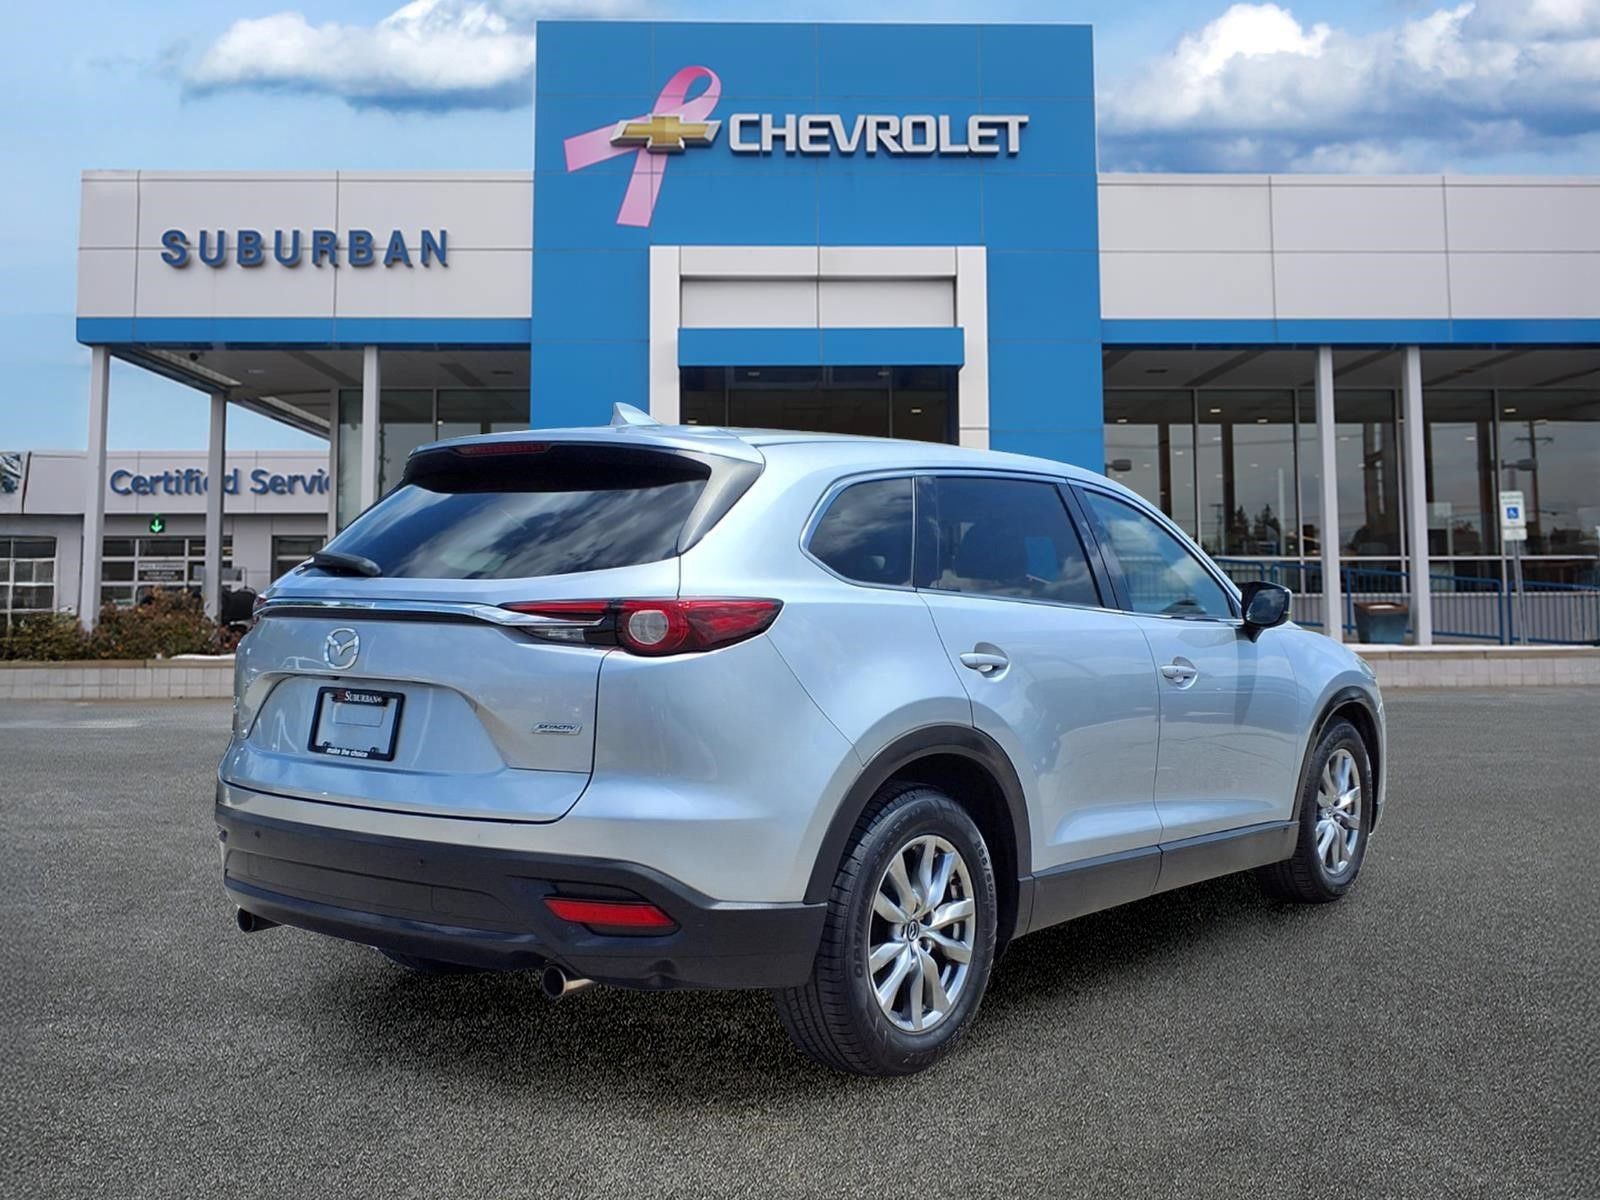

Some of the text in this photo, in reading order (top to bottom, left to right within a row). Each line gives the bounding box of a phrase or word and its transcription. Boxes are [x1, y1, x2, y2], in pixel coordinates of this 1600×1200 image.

[729, 113, 1030, 153] CHEVROLET
[161, 229, 448, 267] SUBURBAN
[110, 468, 330, 495] Certifid Servi
